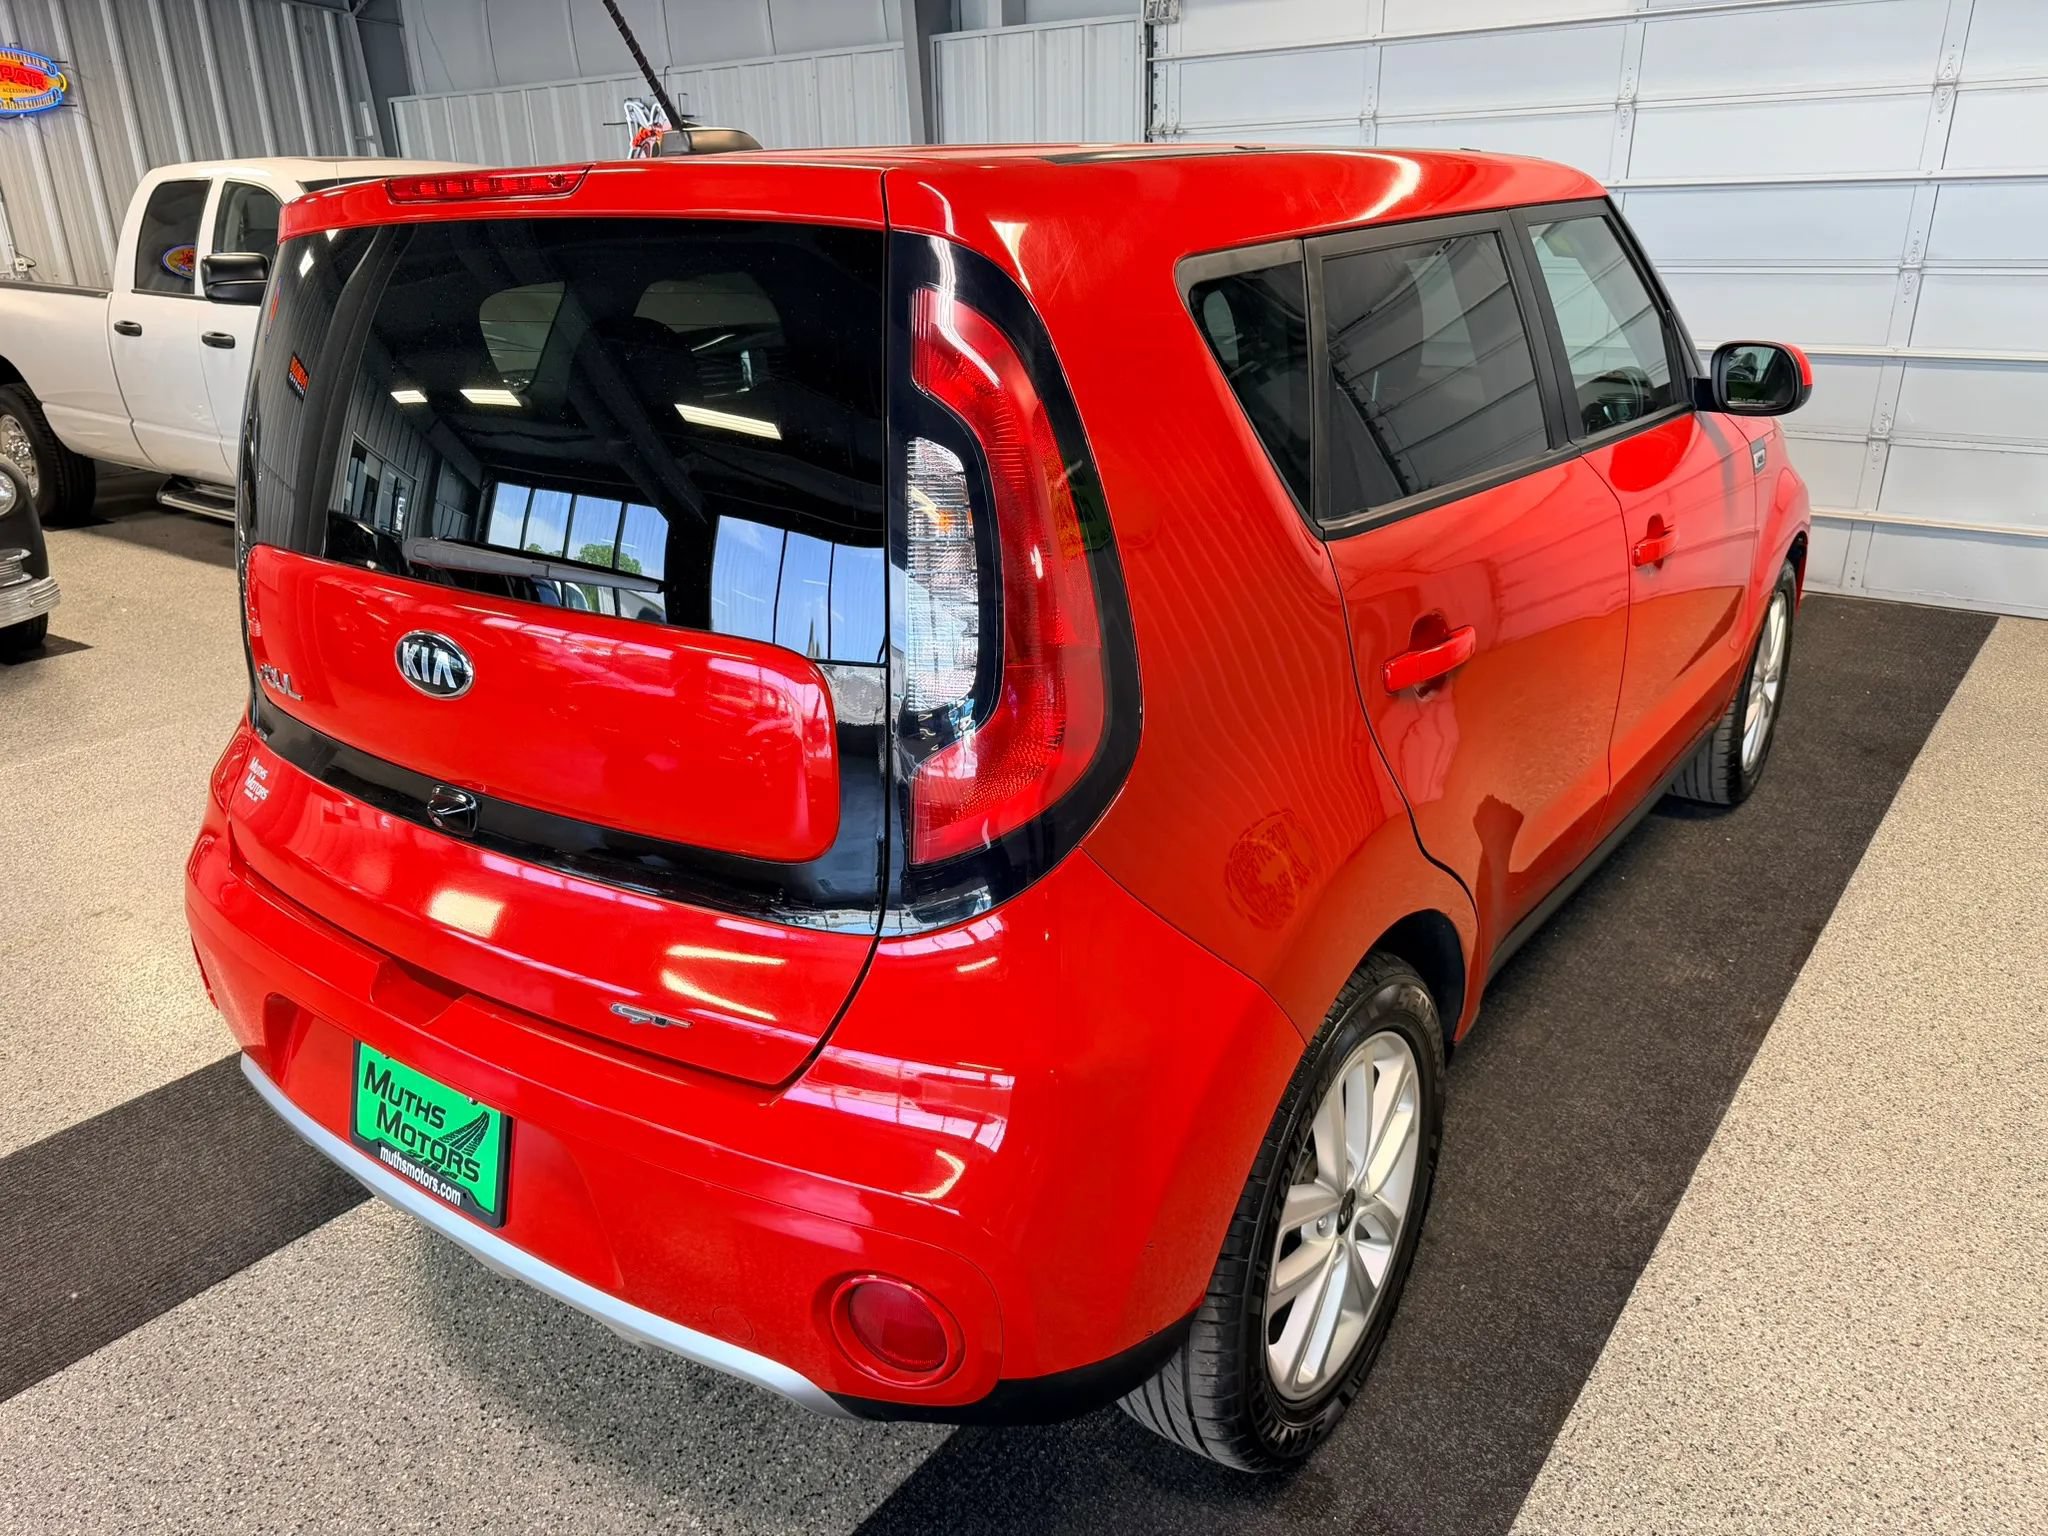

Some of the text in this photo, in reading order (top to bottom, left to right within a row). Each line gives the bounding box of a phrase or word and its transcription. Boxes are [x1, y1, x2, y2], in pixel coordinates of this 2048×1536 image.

[402, 641, 457, 688] KIA
[363, 1060, 447, 1130] MUTHS
[375, 1100, 481, 1183] MOTORS
[379, 1145, 462, 1207] muthsmotors.com
